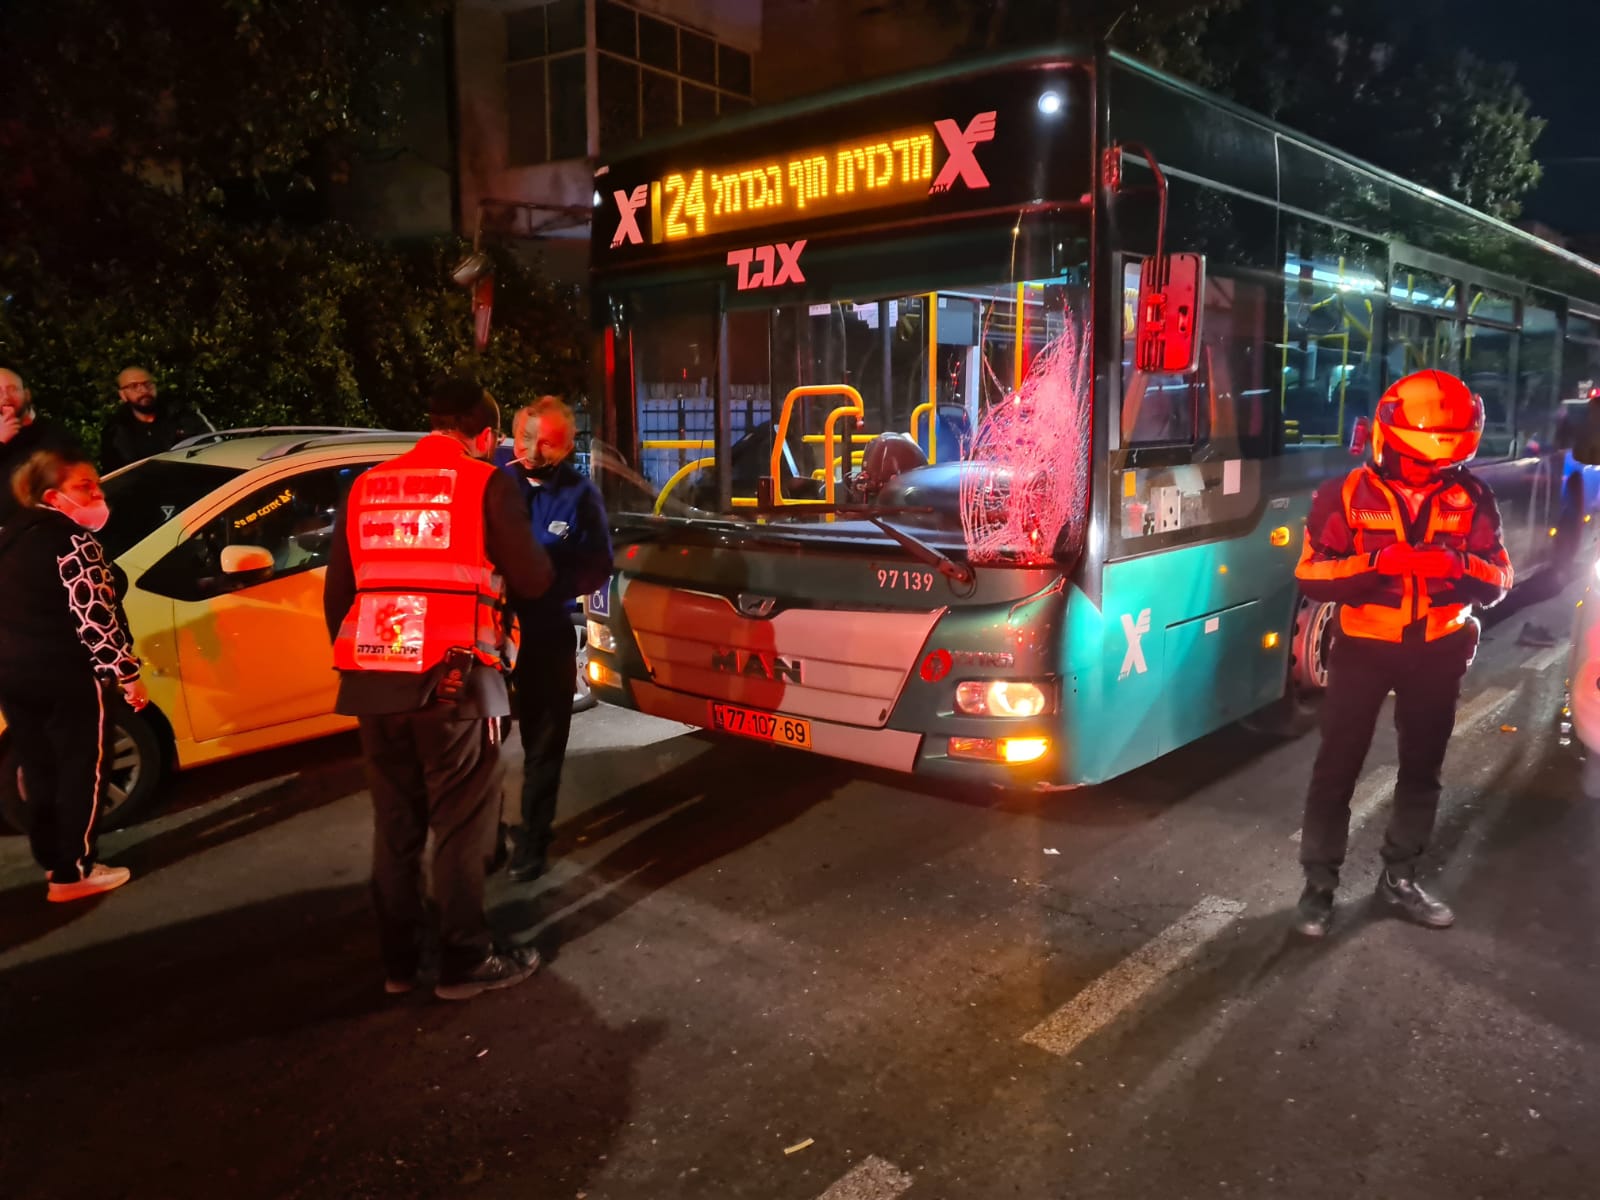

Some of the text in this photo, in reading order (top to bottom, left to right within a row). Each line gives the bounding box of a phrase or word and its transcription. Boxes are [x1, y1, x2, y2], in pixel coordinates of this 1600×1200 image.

[665, 134, 932, 236] מרכזית חוף הכרמל 24
[727, 239, 808, 291] אגד
[357, 643, 385, 654] הצלה
[711, 650, 804, 684] MAN
